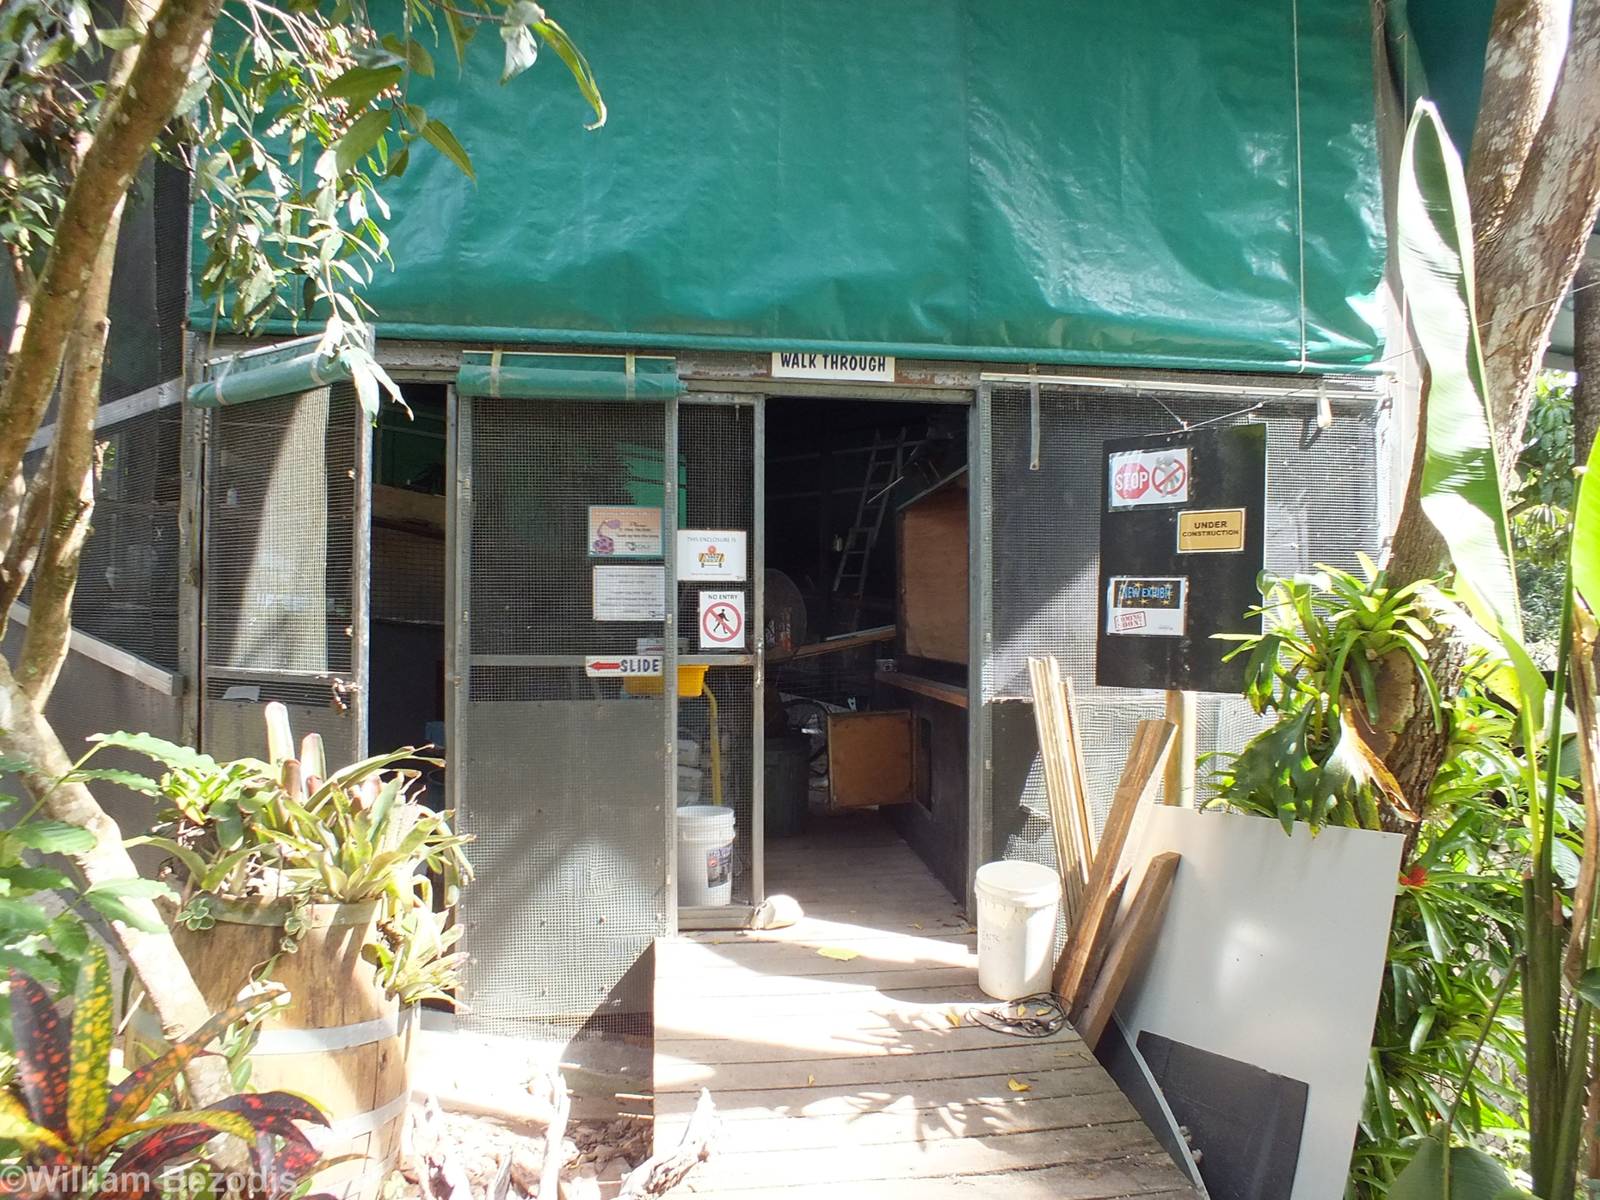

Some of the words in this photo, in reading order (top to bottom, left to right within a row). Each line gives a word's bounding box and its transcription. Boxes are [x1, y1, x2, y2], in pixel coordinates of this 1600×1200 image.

[781, 352, 817, 369] WALK
[823, 355, 886, 372] THROUGH
[1115, 471, 1148, 491] STOP
[1194, 520, 1228, 529] UNDER
[1182, 529, 1239, 537] CONSTRUCTION
[620, 659, 659, 673] SLIDE
